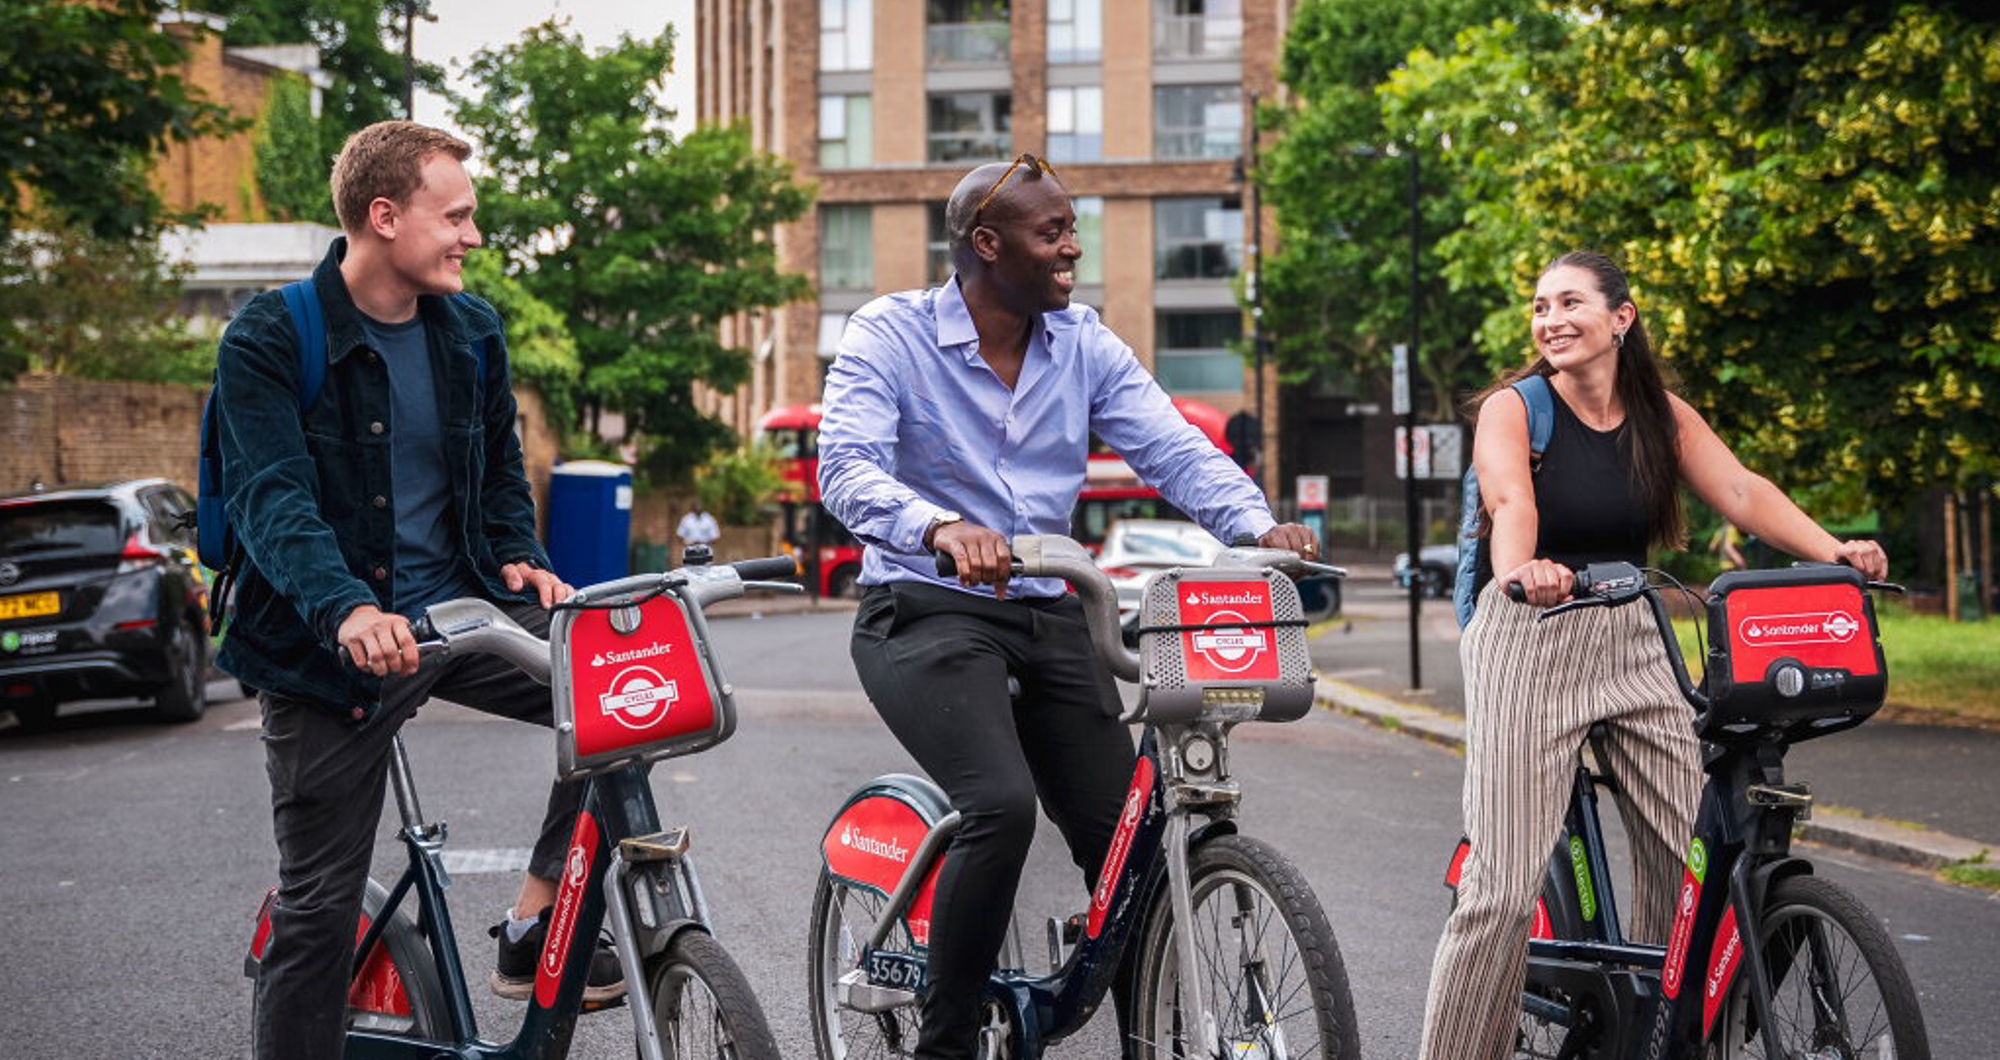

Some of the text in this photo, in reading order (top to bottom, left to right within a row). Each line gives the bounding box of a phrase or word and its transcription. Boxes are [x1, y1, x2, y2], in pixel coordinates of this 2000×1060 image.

[1201, 591, 1263, 604] Santander
[1762, 624, 1818, 637] Santander
[1215, 637, 1245, 645] CYCLES
[606, 641, 673, 665] Santander
[624, 691, 655, 703] CYCLES
[851, 828, 909, 863] Santander
[551, 891, 573, 952] Santander
[870, 957, 928, 988] 35679
